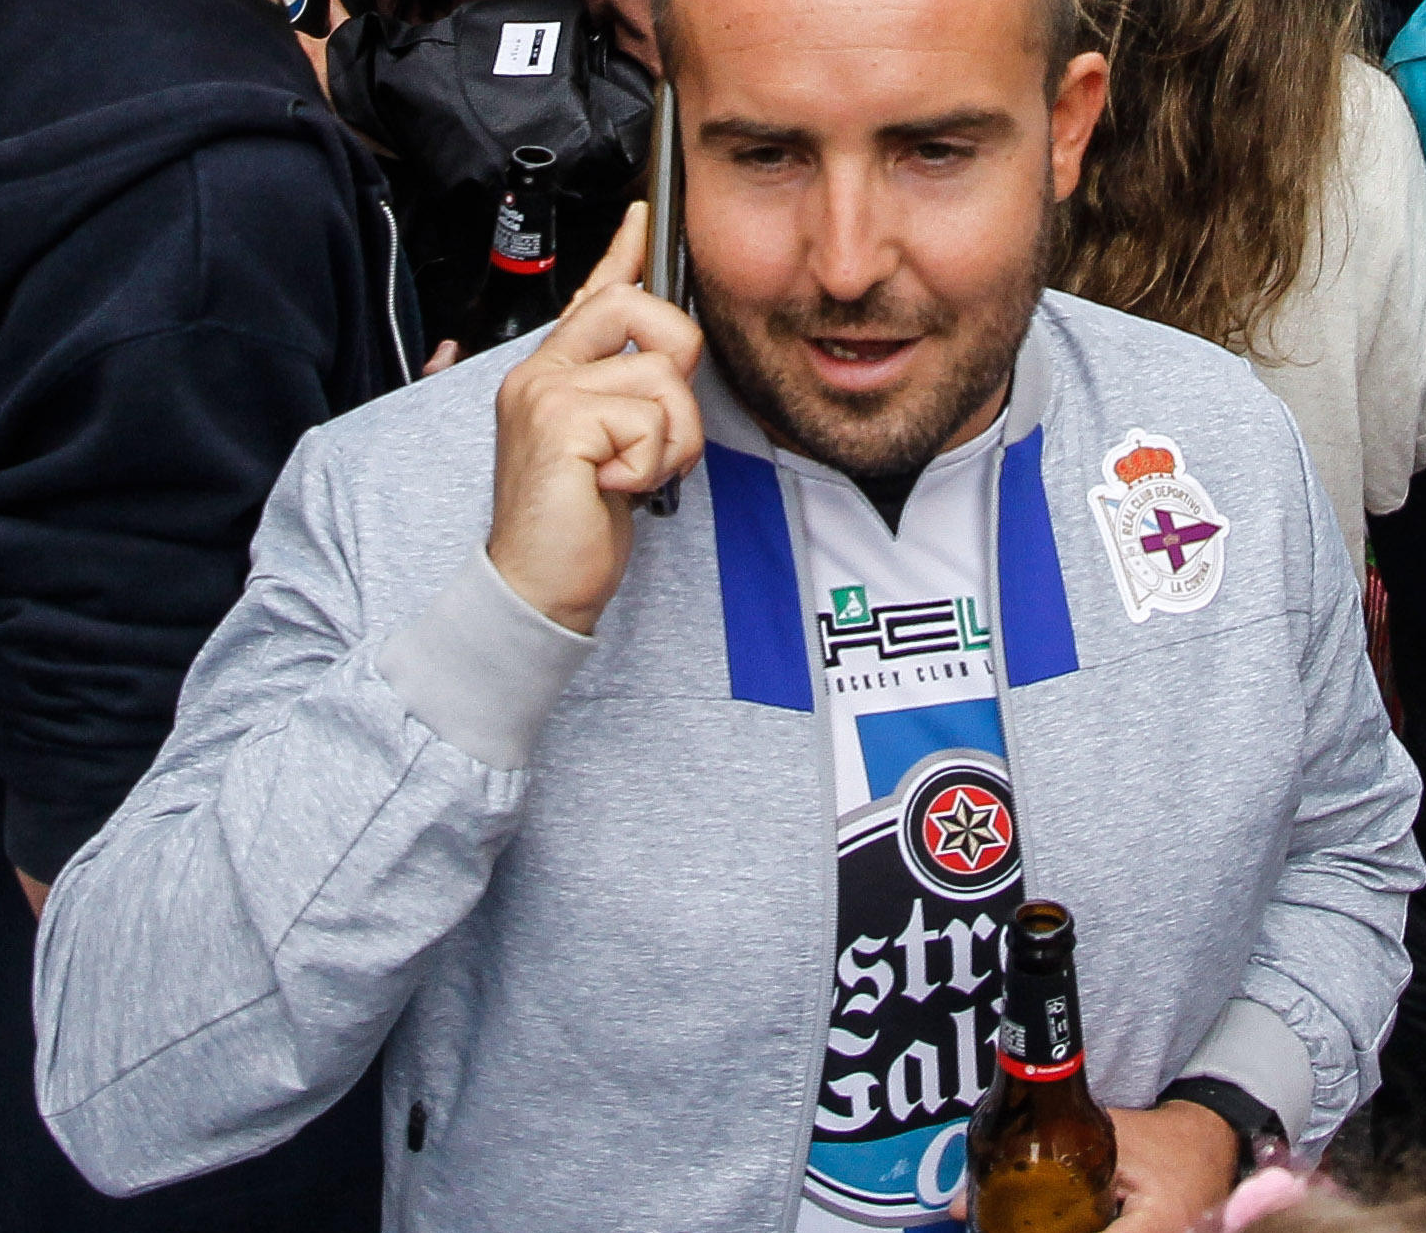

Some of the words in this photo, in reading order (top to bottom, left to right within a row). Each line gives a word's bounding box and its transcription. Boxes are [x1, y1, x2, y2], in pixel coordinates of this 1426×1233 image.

[824, 670, 901, 696] OCKEY
[916, 661, 969, 682] CLUB
[832, 898, 1007, 1015] str
